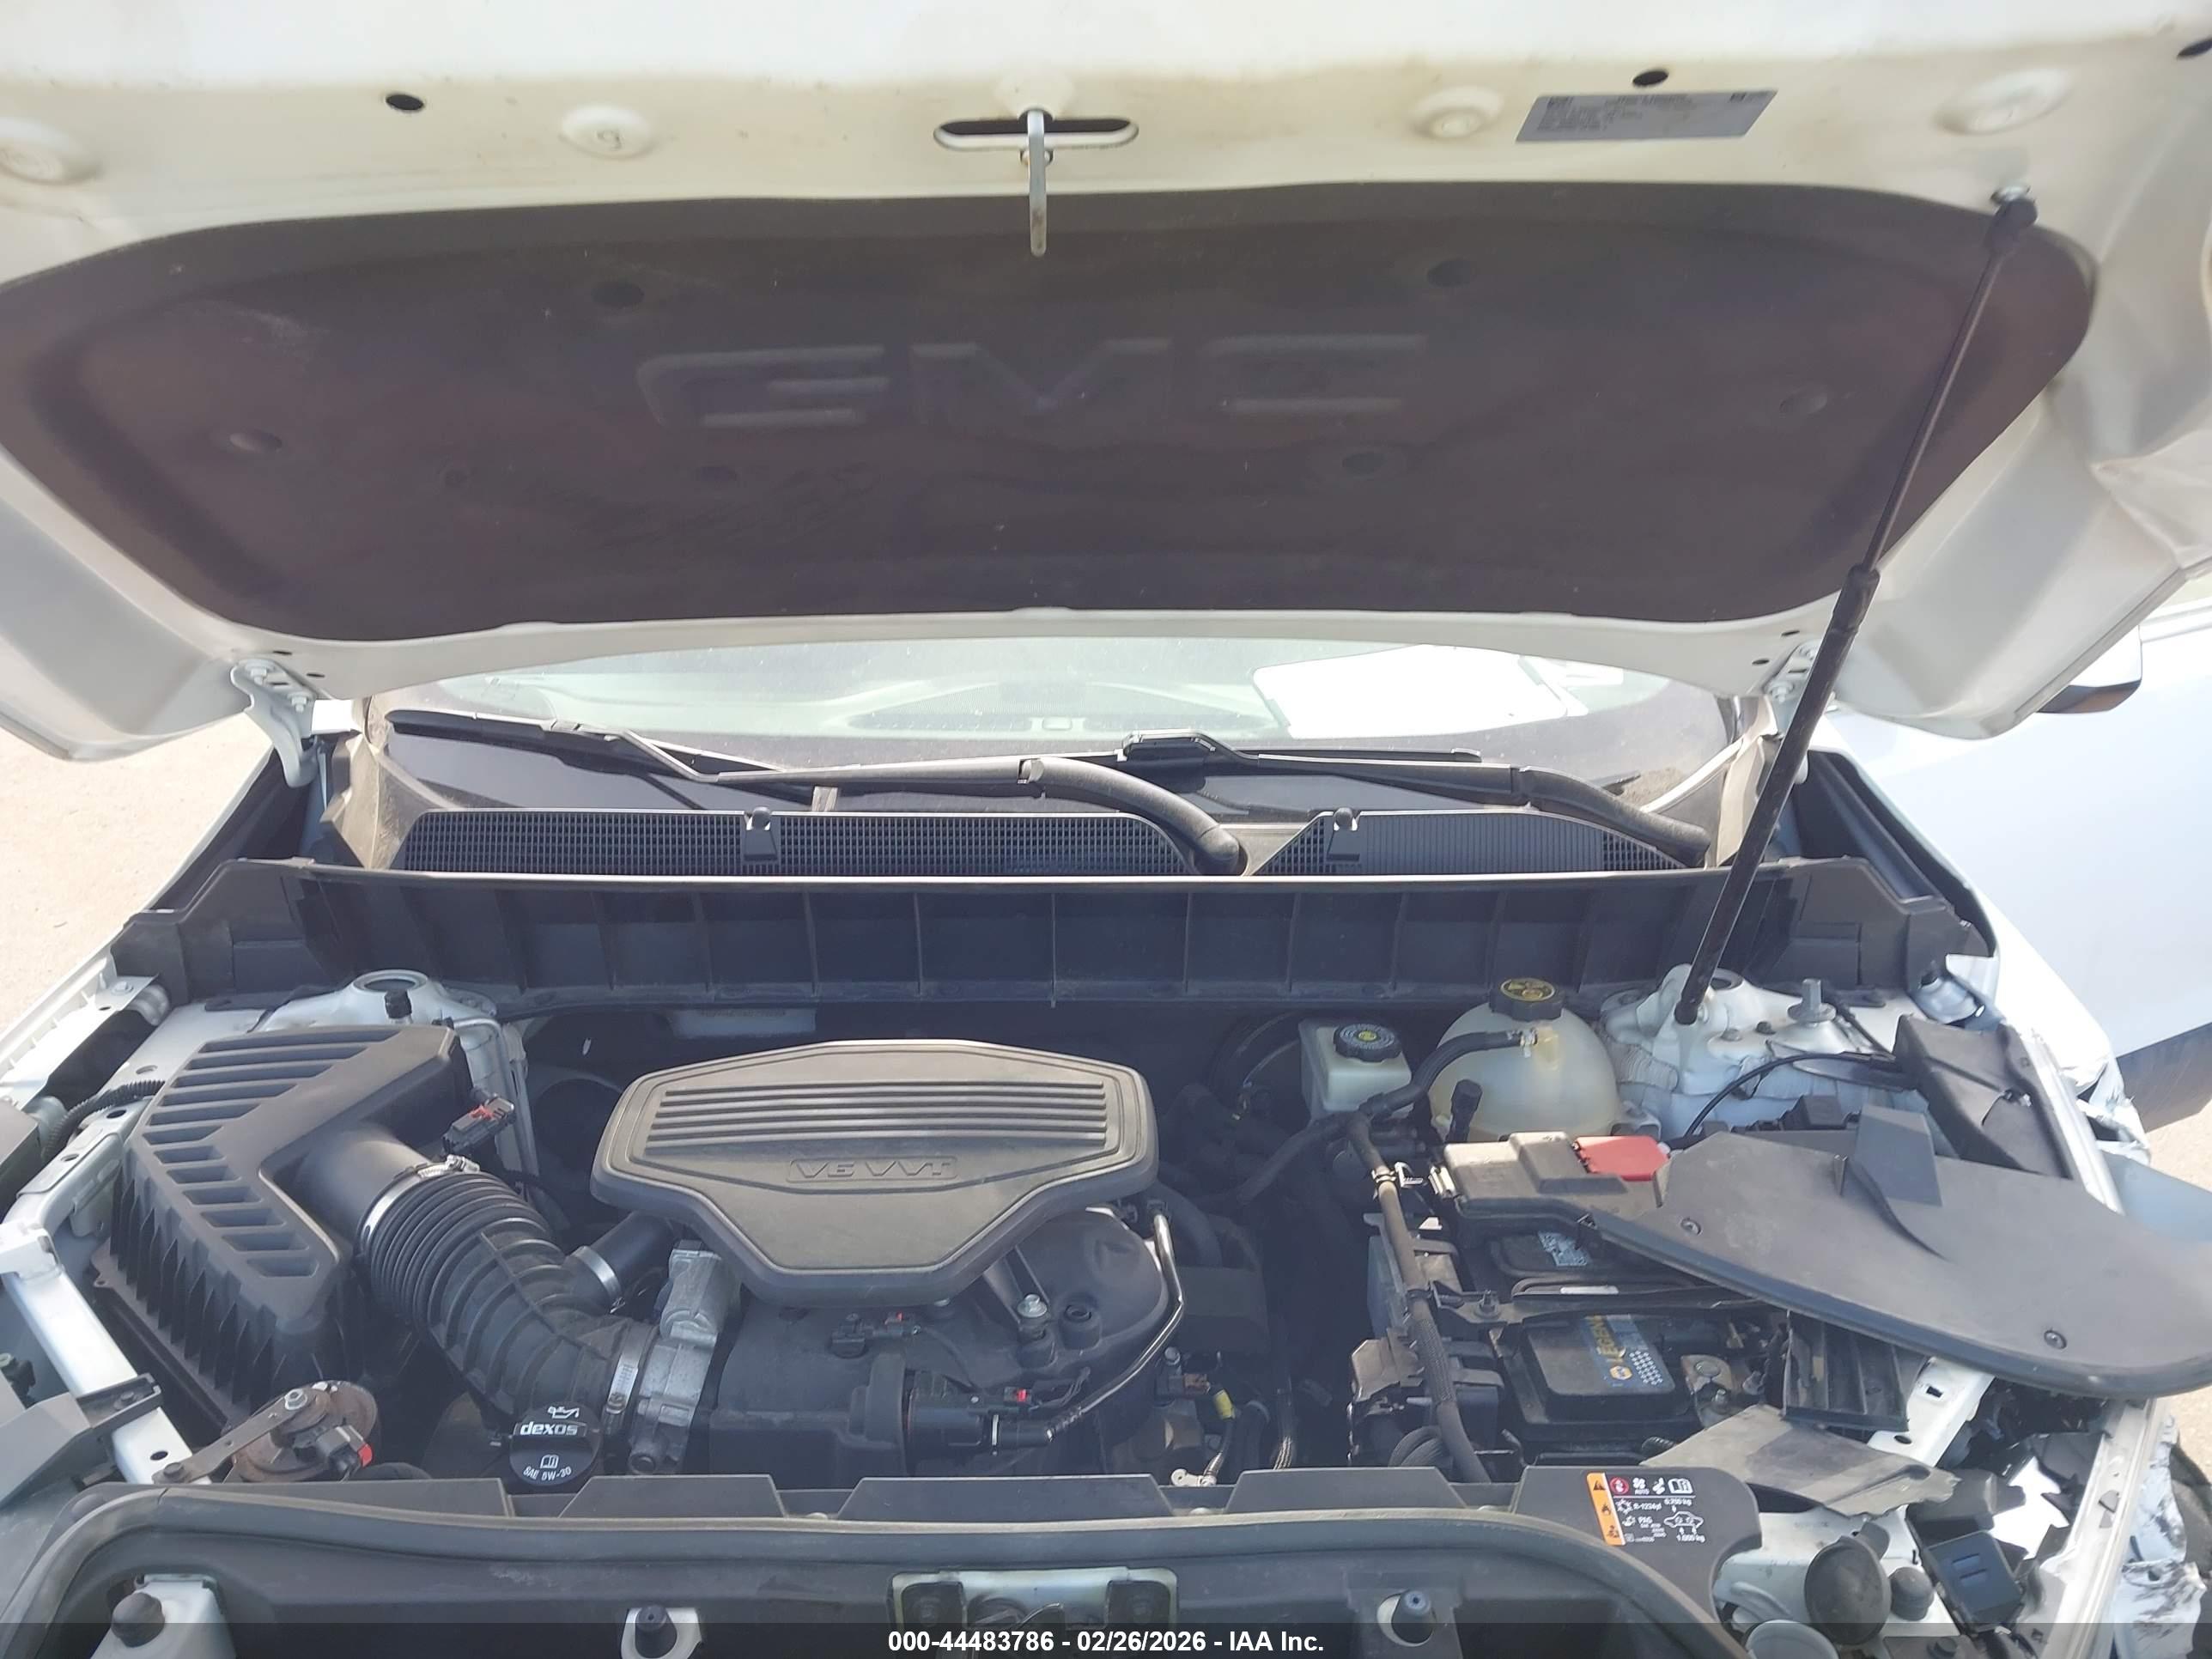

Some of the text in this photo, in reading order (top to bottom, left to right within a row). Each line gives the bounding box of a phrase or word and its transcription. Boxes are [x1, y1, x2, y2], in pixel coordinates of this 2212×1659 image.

[864, 1160, 951, 1177] VVT
[520, 1421, 578, 1436] dexos
[523, 1466, 572, 1481] SAE 5W-30
